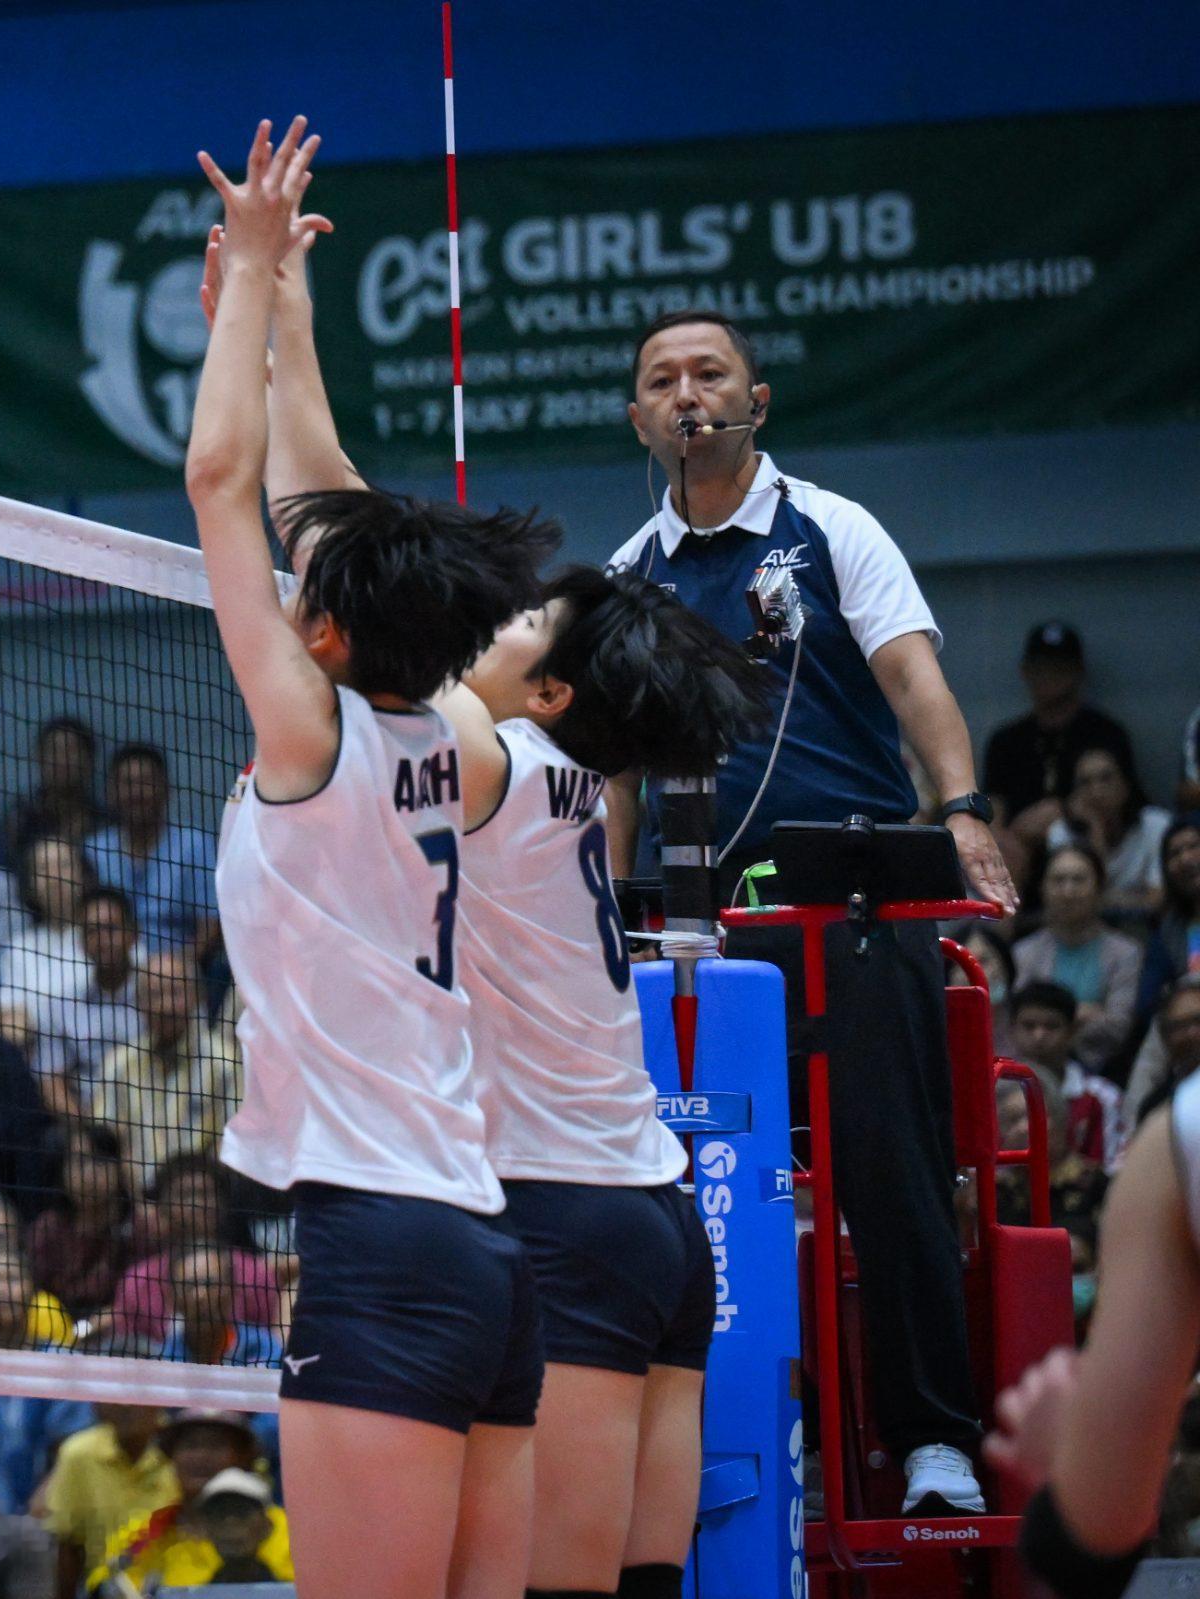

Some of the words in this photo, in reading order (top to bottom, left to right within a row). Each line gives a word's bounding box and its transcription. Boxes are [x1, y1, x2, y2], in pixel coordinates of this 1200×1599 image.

[770, 190, 917, 276] U18
[502, 278, 768, 335] VOLLEYBALL
[774, 256, 1095, 317] CHAMPIONSHIP
[578, 819, 631, 993] 8
[656, 1096, 710, 1117] FIVB
[702, 1183, 739, 1333] Senoh
[919, 1526, 980, 1541] Senoh
